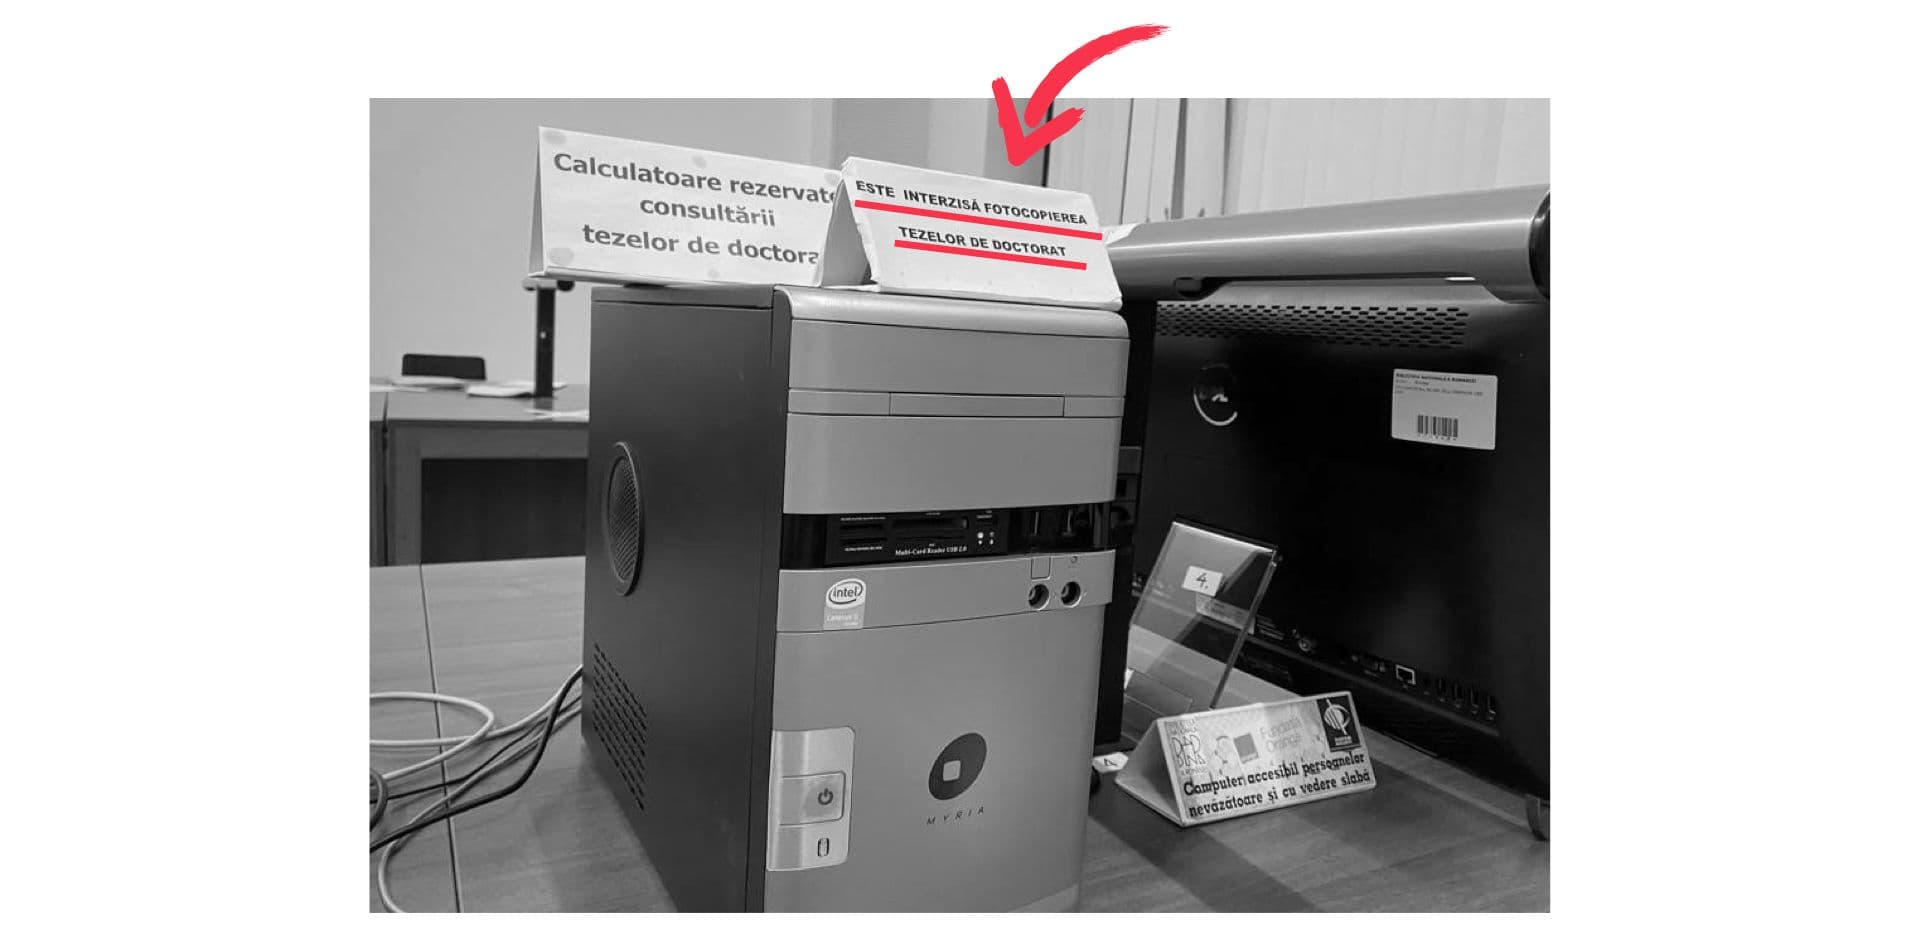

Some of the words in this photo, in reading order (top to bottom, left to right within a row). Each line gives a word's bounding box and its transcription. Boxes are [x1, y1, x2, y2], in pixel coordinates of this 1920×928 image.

[553, 152, 722, 191] Calculatoare
[729, 178, 837, 204] rezervat
[639, 199, 776, 227] consultării
[855, 180, 895, 197] ESTE
[903, 190, 980, 213] INTERZISĂ
[984, 203, 1088, 225] FOTOCOPIEREA
[582, 223, 680, 251] tezelor
[687, 236, 721, 255] de
[898, 226, 967, 247] TEZELOR
[970, 236, 989, 249] DE
[992, 240, 1067, 257] DOCTORAT
[832, 585, 859, 599] intel
[1196, 572, 1209, 590] 4.
[1183, 774, 1244, 796] Computer
[1248, 762, 1299, 784] accesibil
[1302, 751, 1365, 777] persoanelor
[1189, 792, 1263, 818] nevăzătoare
[1282, 786, 1297, 797] cu
[1300, 777, 1337, 794] vedere
[1341, 769, 1371, 787] slabă
[926, 805, 985, 826] MYRIA
